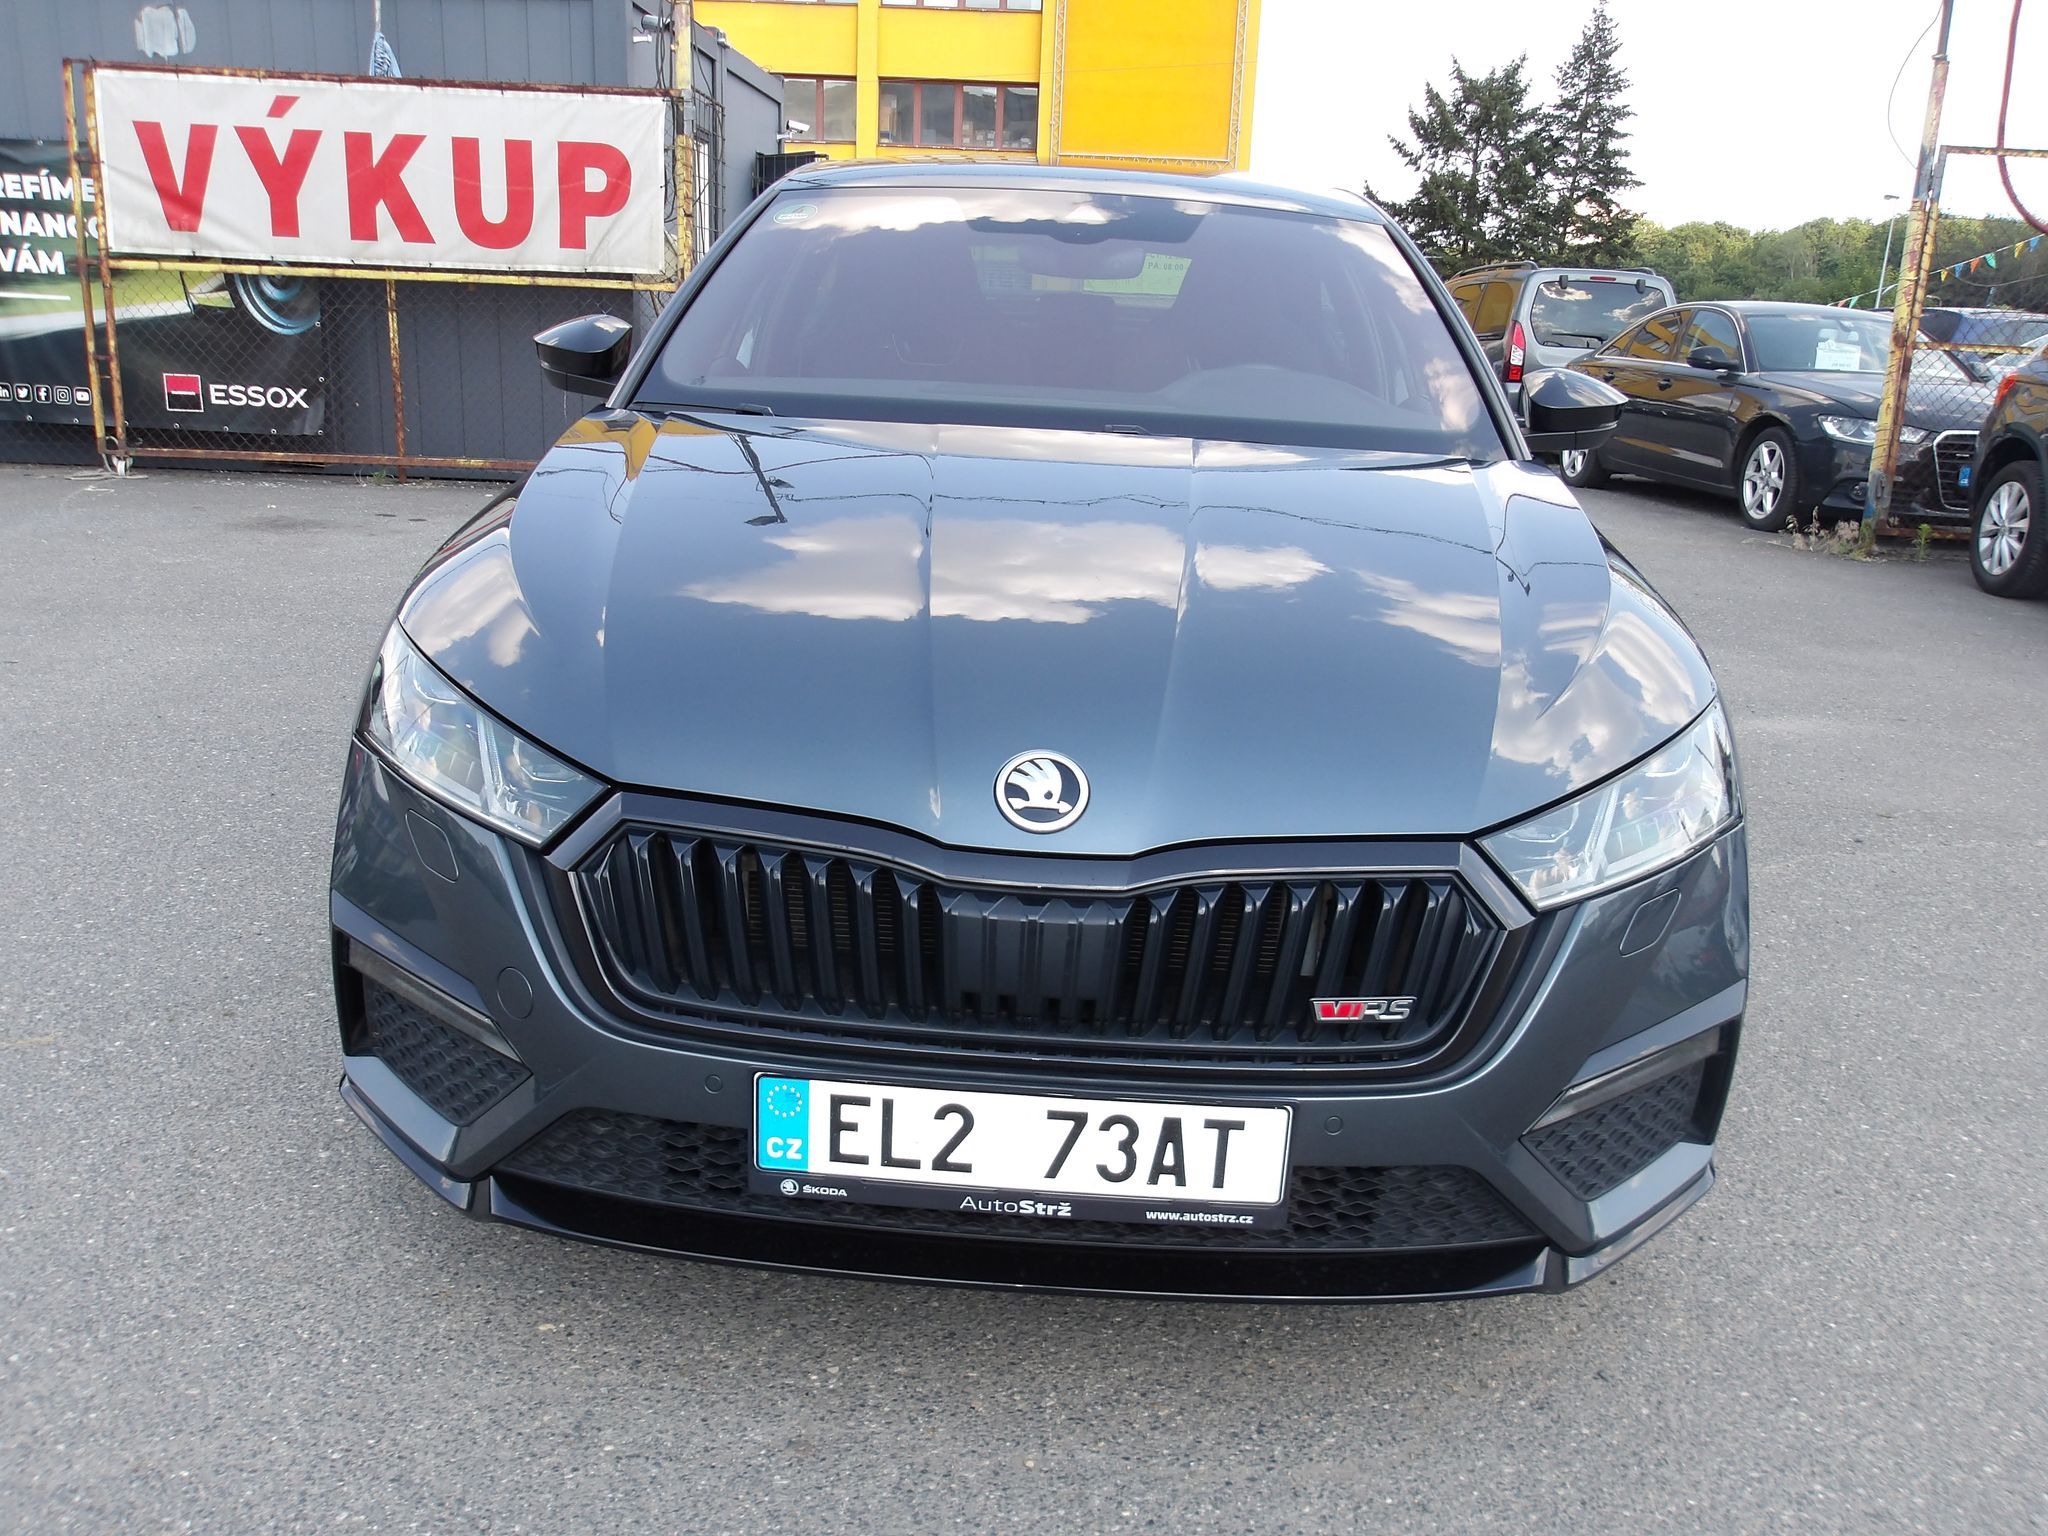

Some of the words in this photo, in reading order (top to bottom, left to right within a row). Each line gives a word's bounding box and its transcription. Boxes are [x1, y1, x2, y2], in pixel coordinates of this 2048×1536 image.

[132, 95, 632, 249] VÝKUP
[0, 243, 66, 275] VÁM
[209, 383, 309, 409] ESSOX
[766, 1136, 803, 1160] CZ
[829, 1093, 975, 1173] EL2
[1043, 1109, 1246, 1189] 73AT
[803, 1184, 848, 1197] ŠKODA
[959, 1196, 1072, 1217] AutoStrž
[1146, 1209, 1254, 1224] www.autostrz.cz
